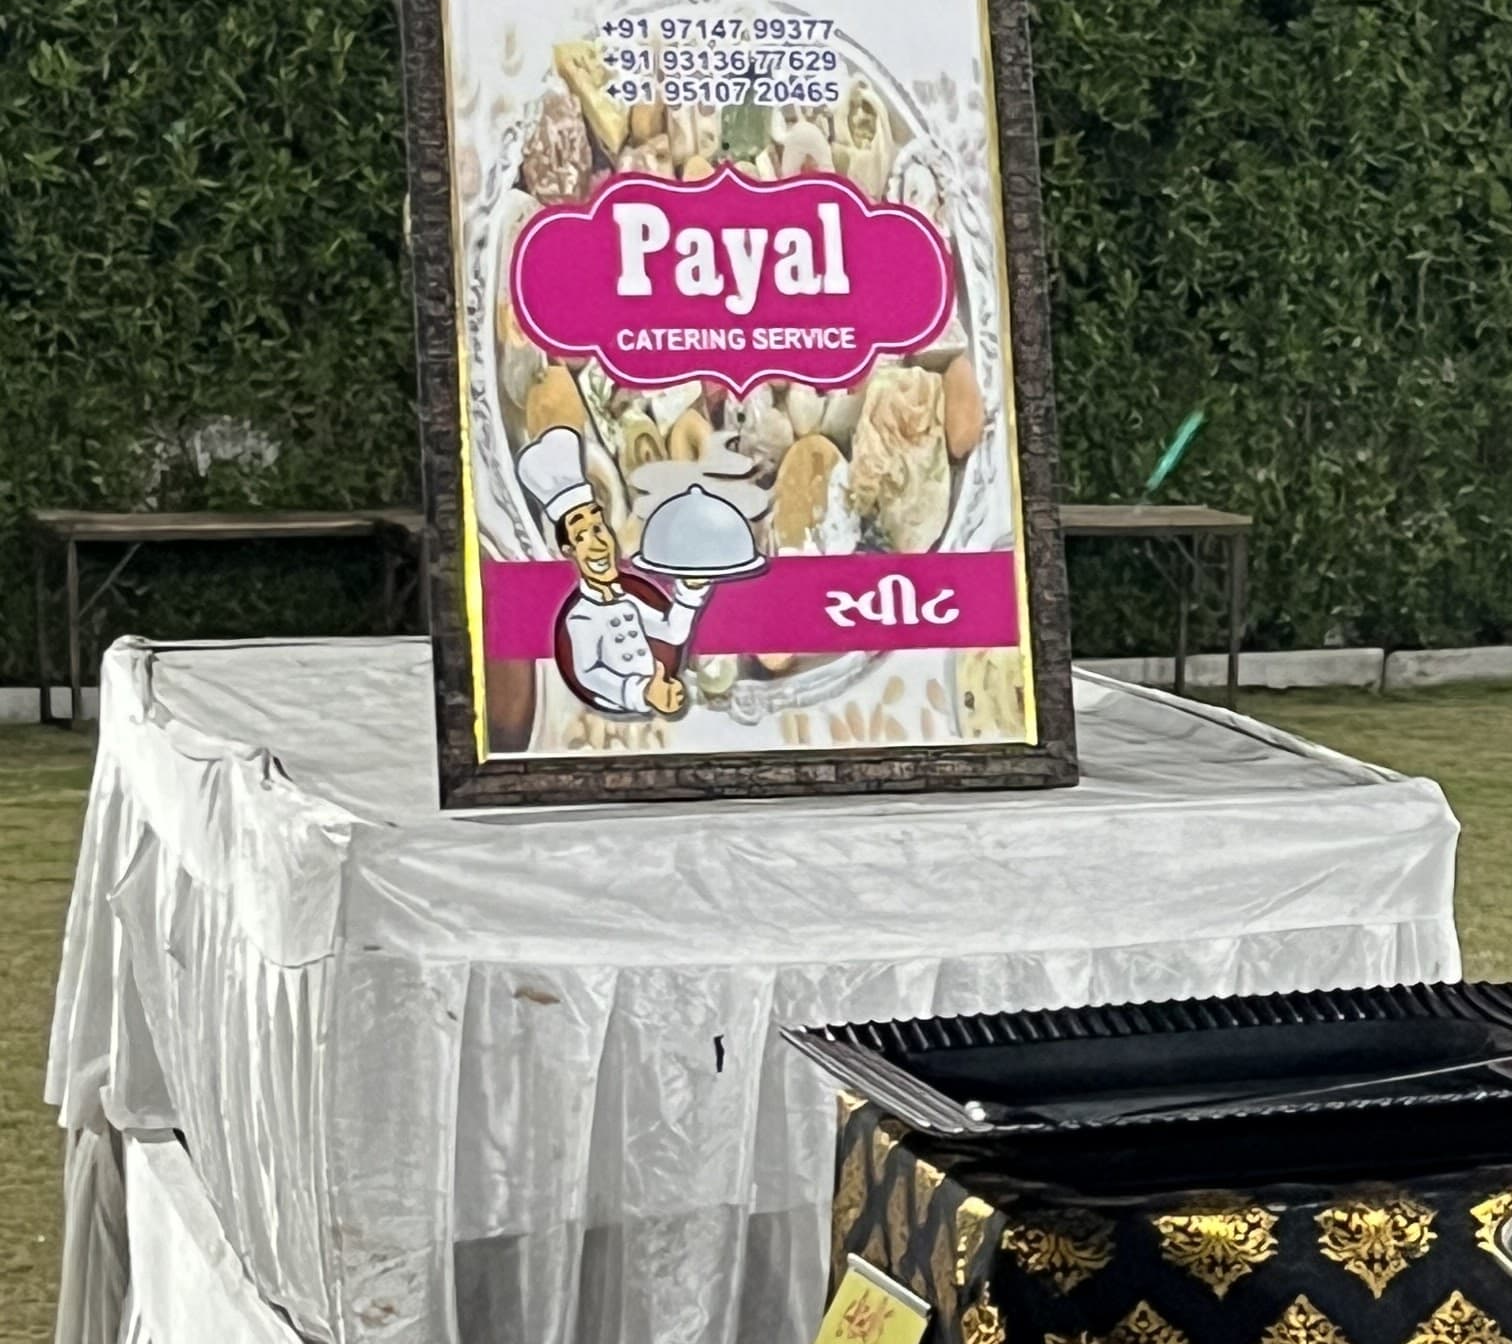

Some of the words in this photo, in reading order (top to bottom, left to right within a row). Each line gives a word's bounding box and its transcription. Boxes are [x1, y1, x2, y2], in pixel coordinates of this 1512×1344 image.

[602, 18, 649, 39] +91
[660, 18, 743, 40] 97147
[753, 18, 834, 40] 99377
[603, 50, 650, 71] +91
[663, 50, 745, 71] 93136
[755, 50, 837, 71] 77629
[606, 80, 652, 102] +91
[665, 81, 746, 103] 95107
[757, 81, 839, 102] 20465
[612, 202, 851, 316] Payal
[616, 328, 746, 351] CATERING
[752, 327, 857, 350] SERVICE
[824, 573, 960, 627] સ્વીટ
